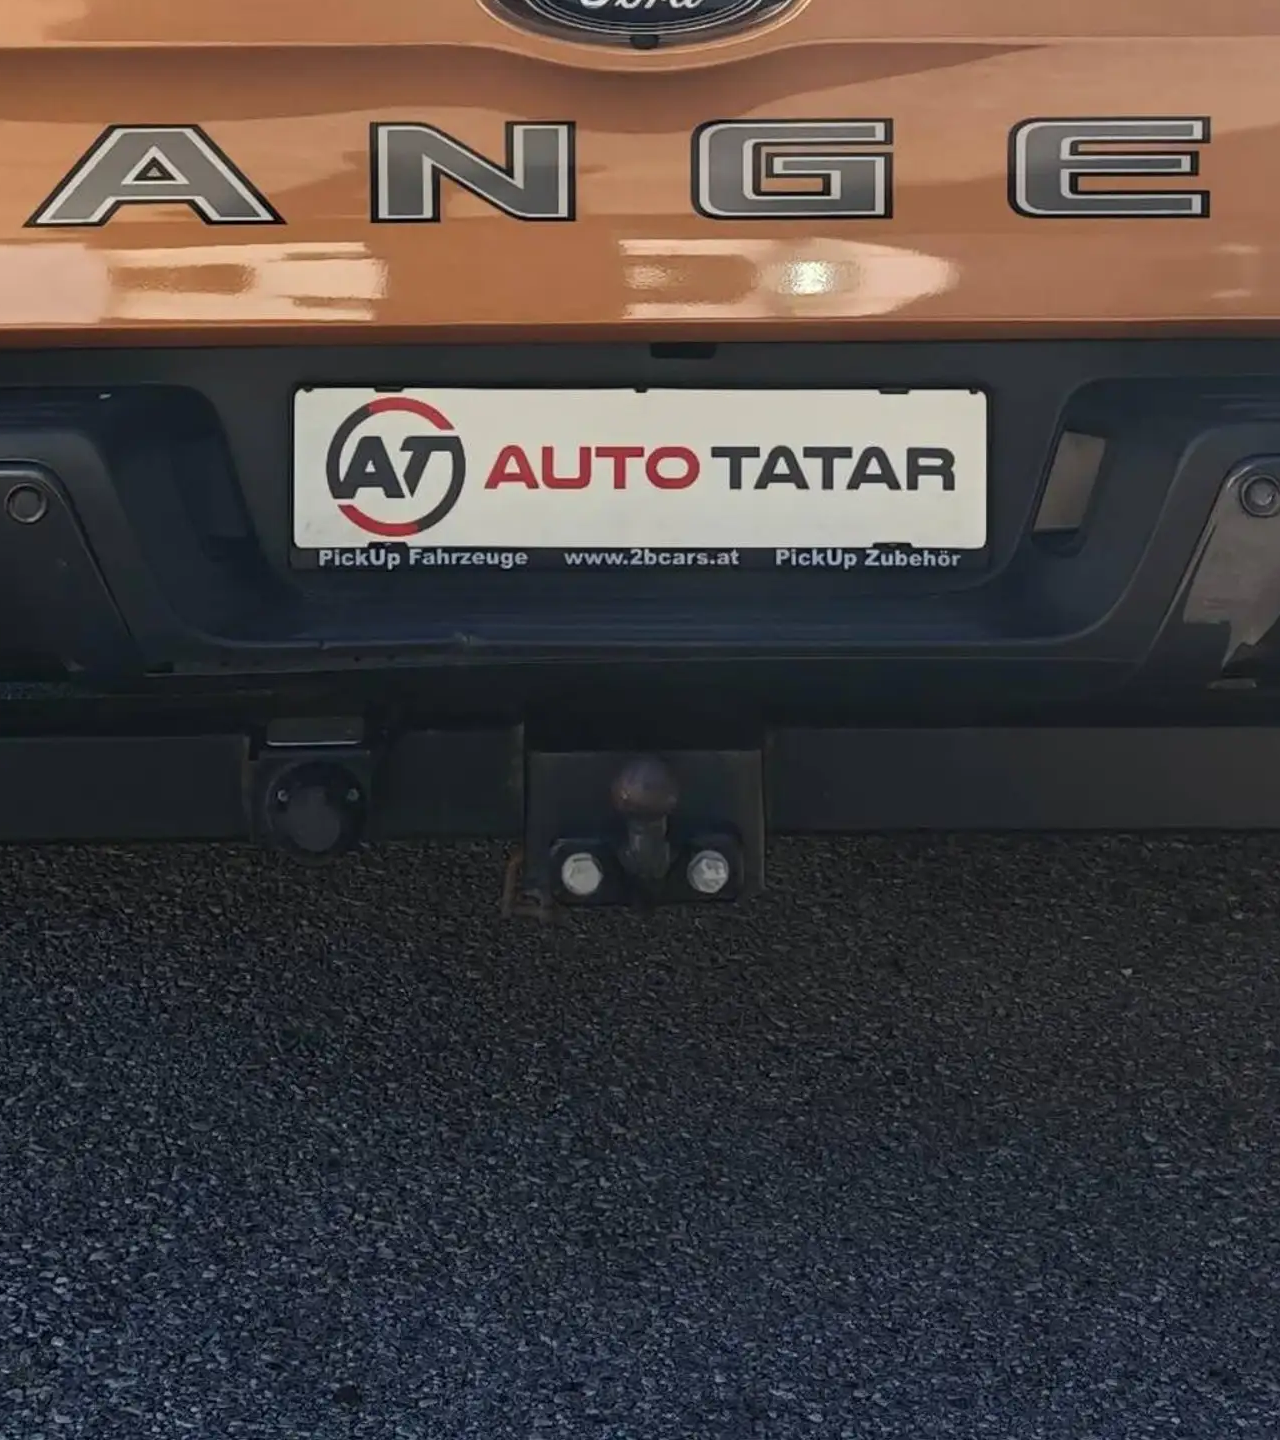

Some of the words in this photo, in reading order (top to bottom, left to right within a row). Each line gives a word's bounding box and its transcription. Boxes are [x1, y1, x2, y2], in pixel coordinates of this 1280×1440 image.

[483, 444, 701, 491] AUTO
[711, 445, 957, 491] TATAR
[318, 548, 401, 570] PickUp
[408, 548, 529, 569] Fahrzeuge
[563, 548, 740, 567] www.2bcars.at
[774, 549, 857, 570] PickUp
[863, 548, 962, 568] Zubehör
